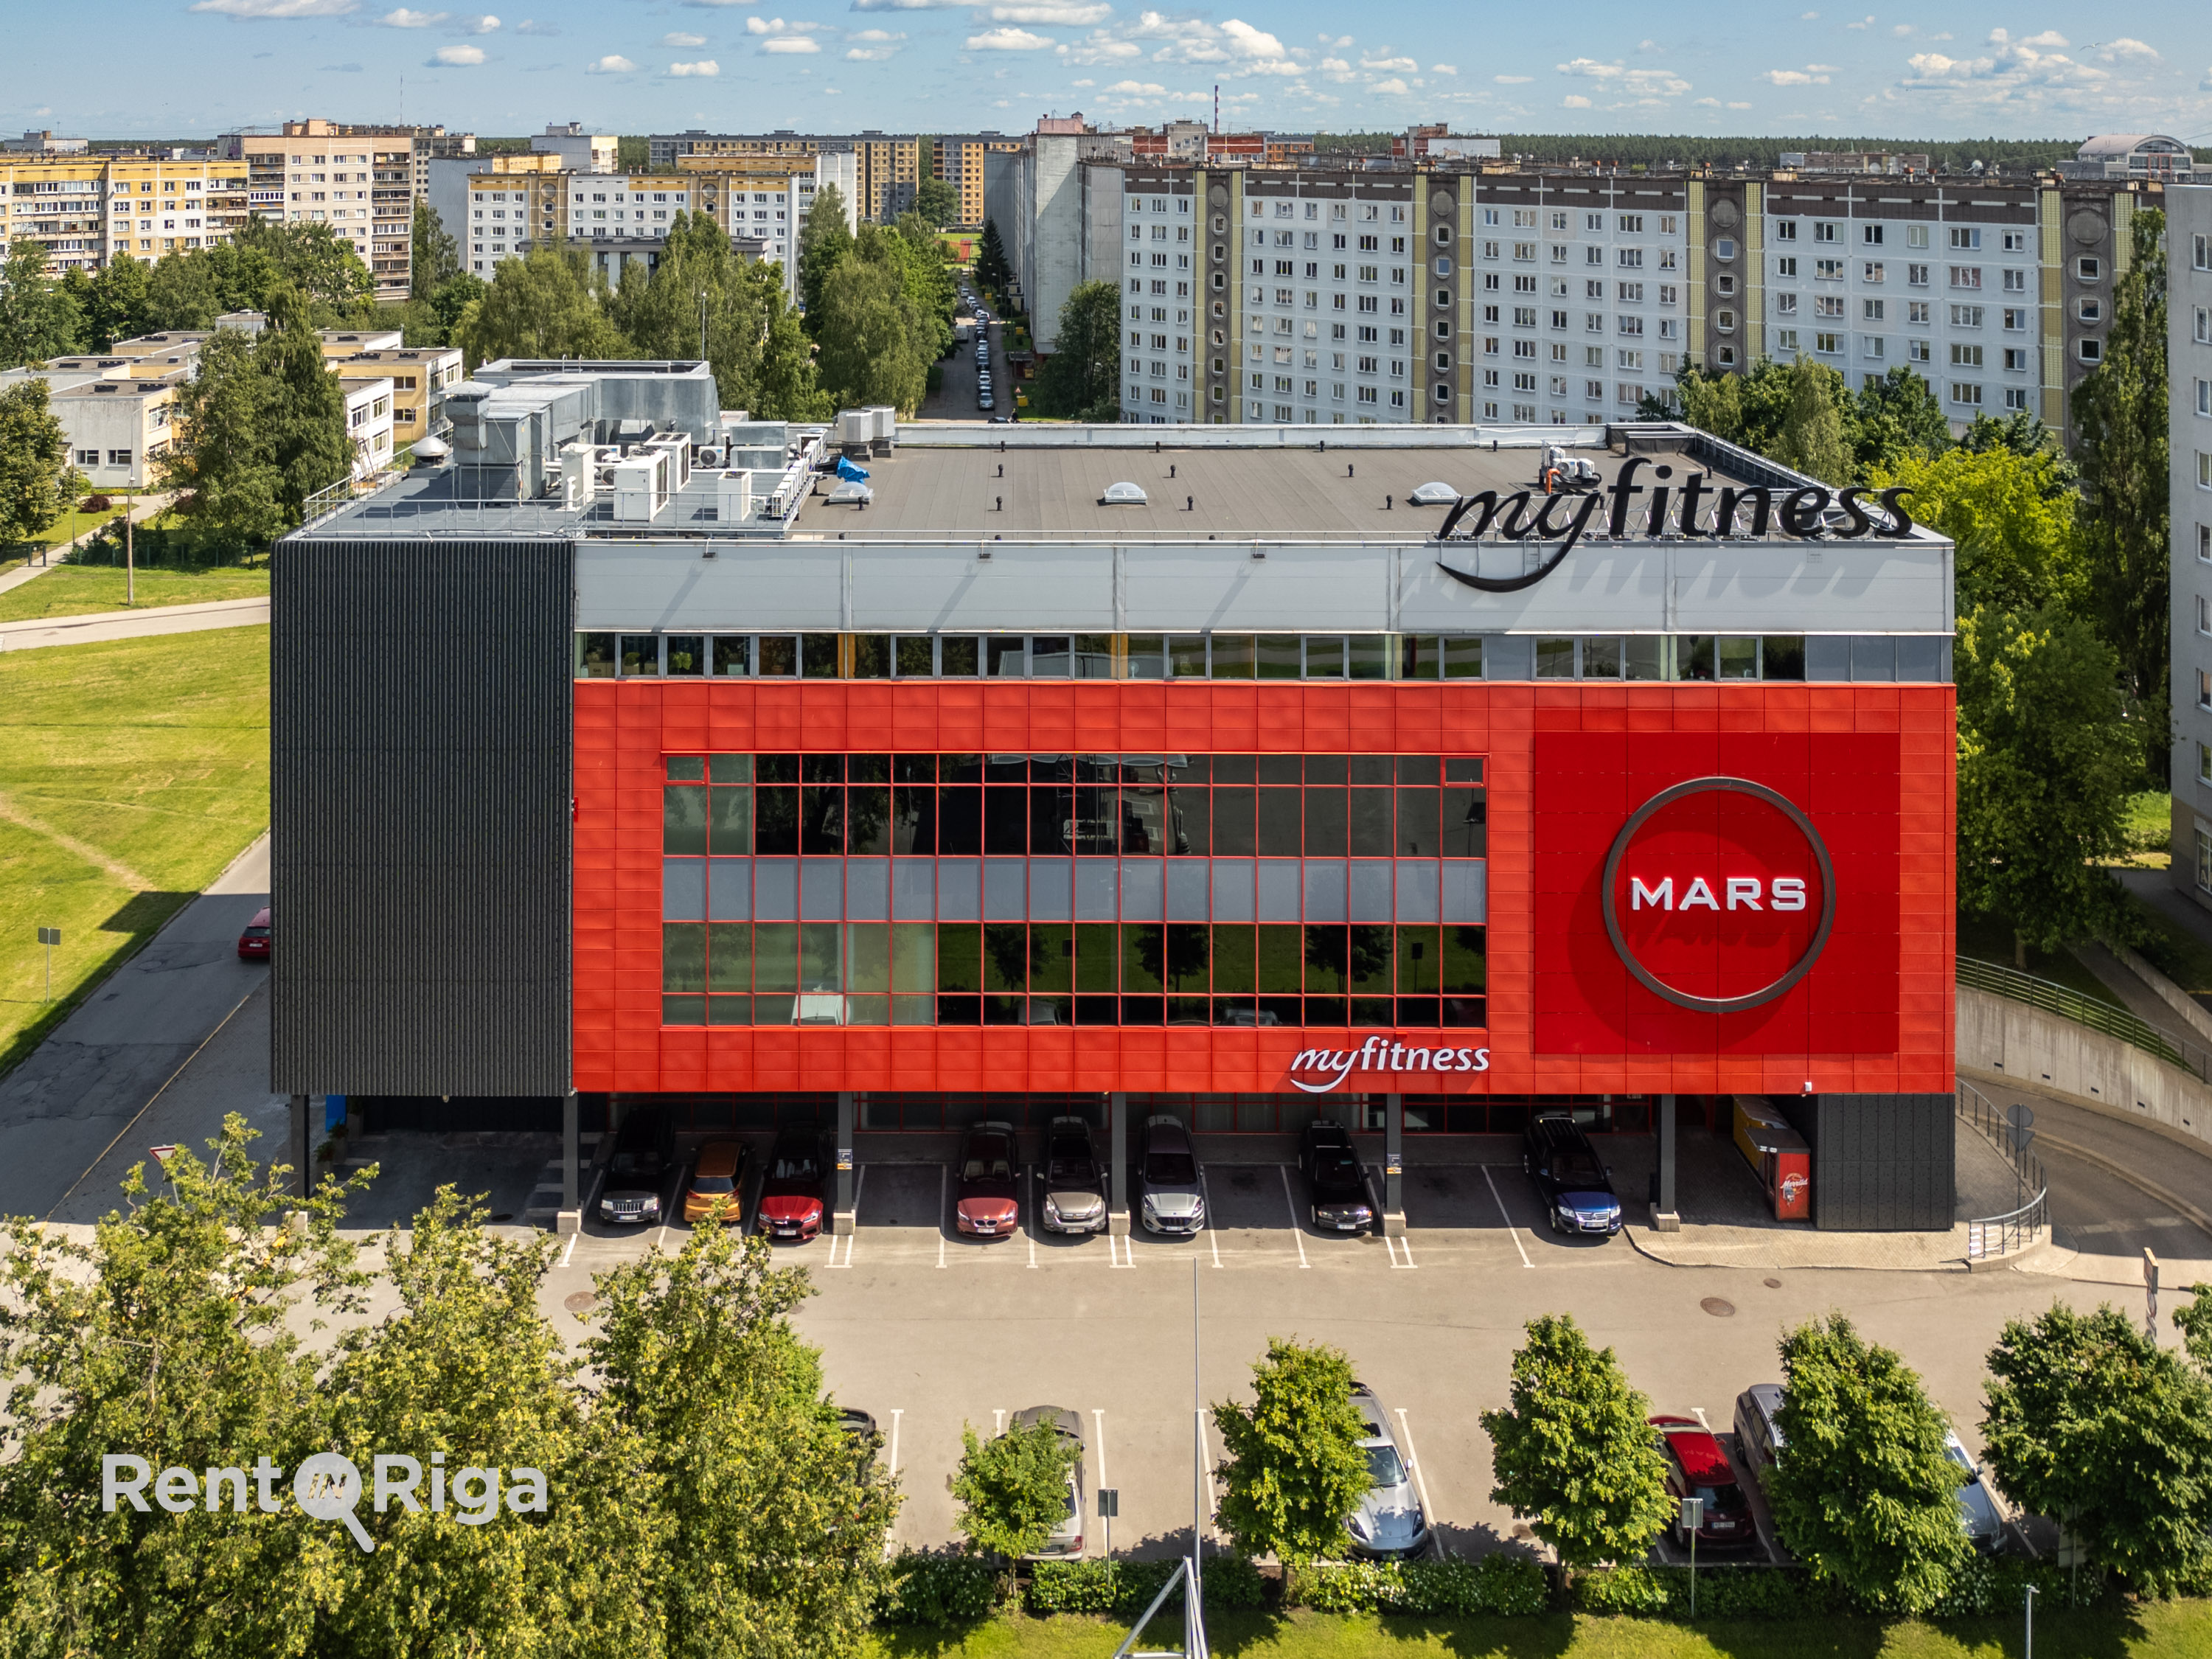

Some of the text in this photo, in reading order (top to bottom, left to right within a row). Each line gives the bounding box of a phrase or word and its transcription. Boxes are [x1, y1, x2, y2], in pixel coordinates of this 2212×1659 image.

[1436, 457, 1914, 592] myfitness
[1631, 876, 1806, 911] MARS
[1290, 1036, 1489, 1093] myfitness
